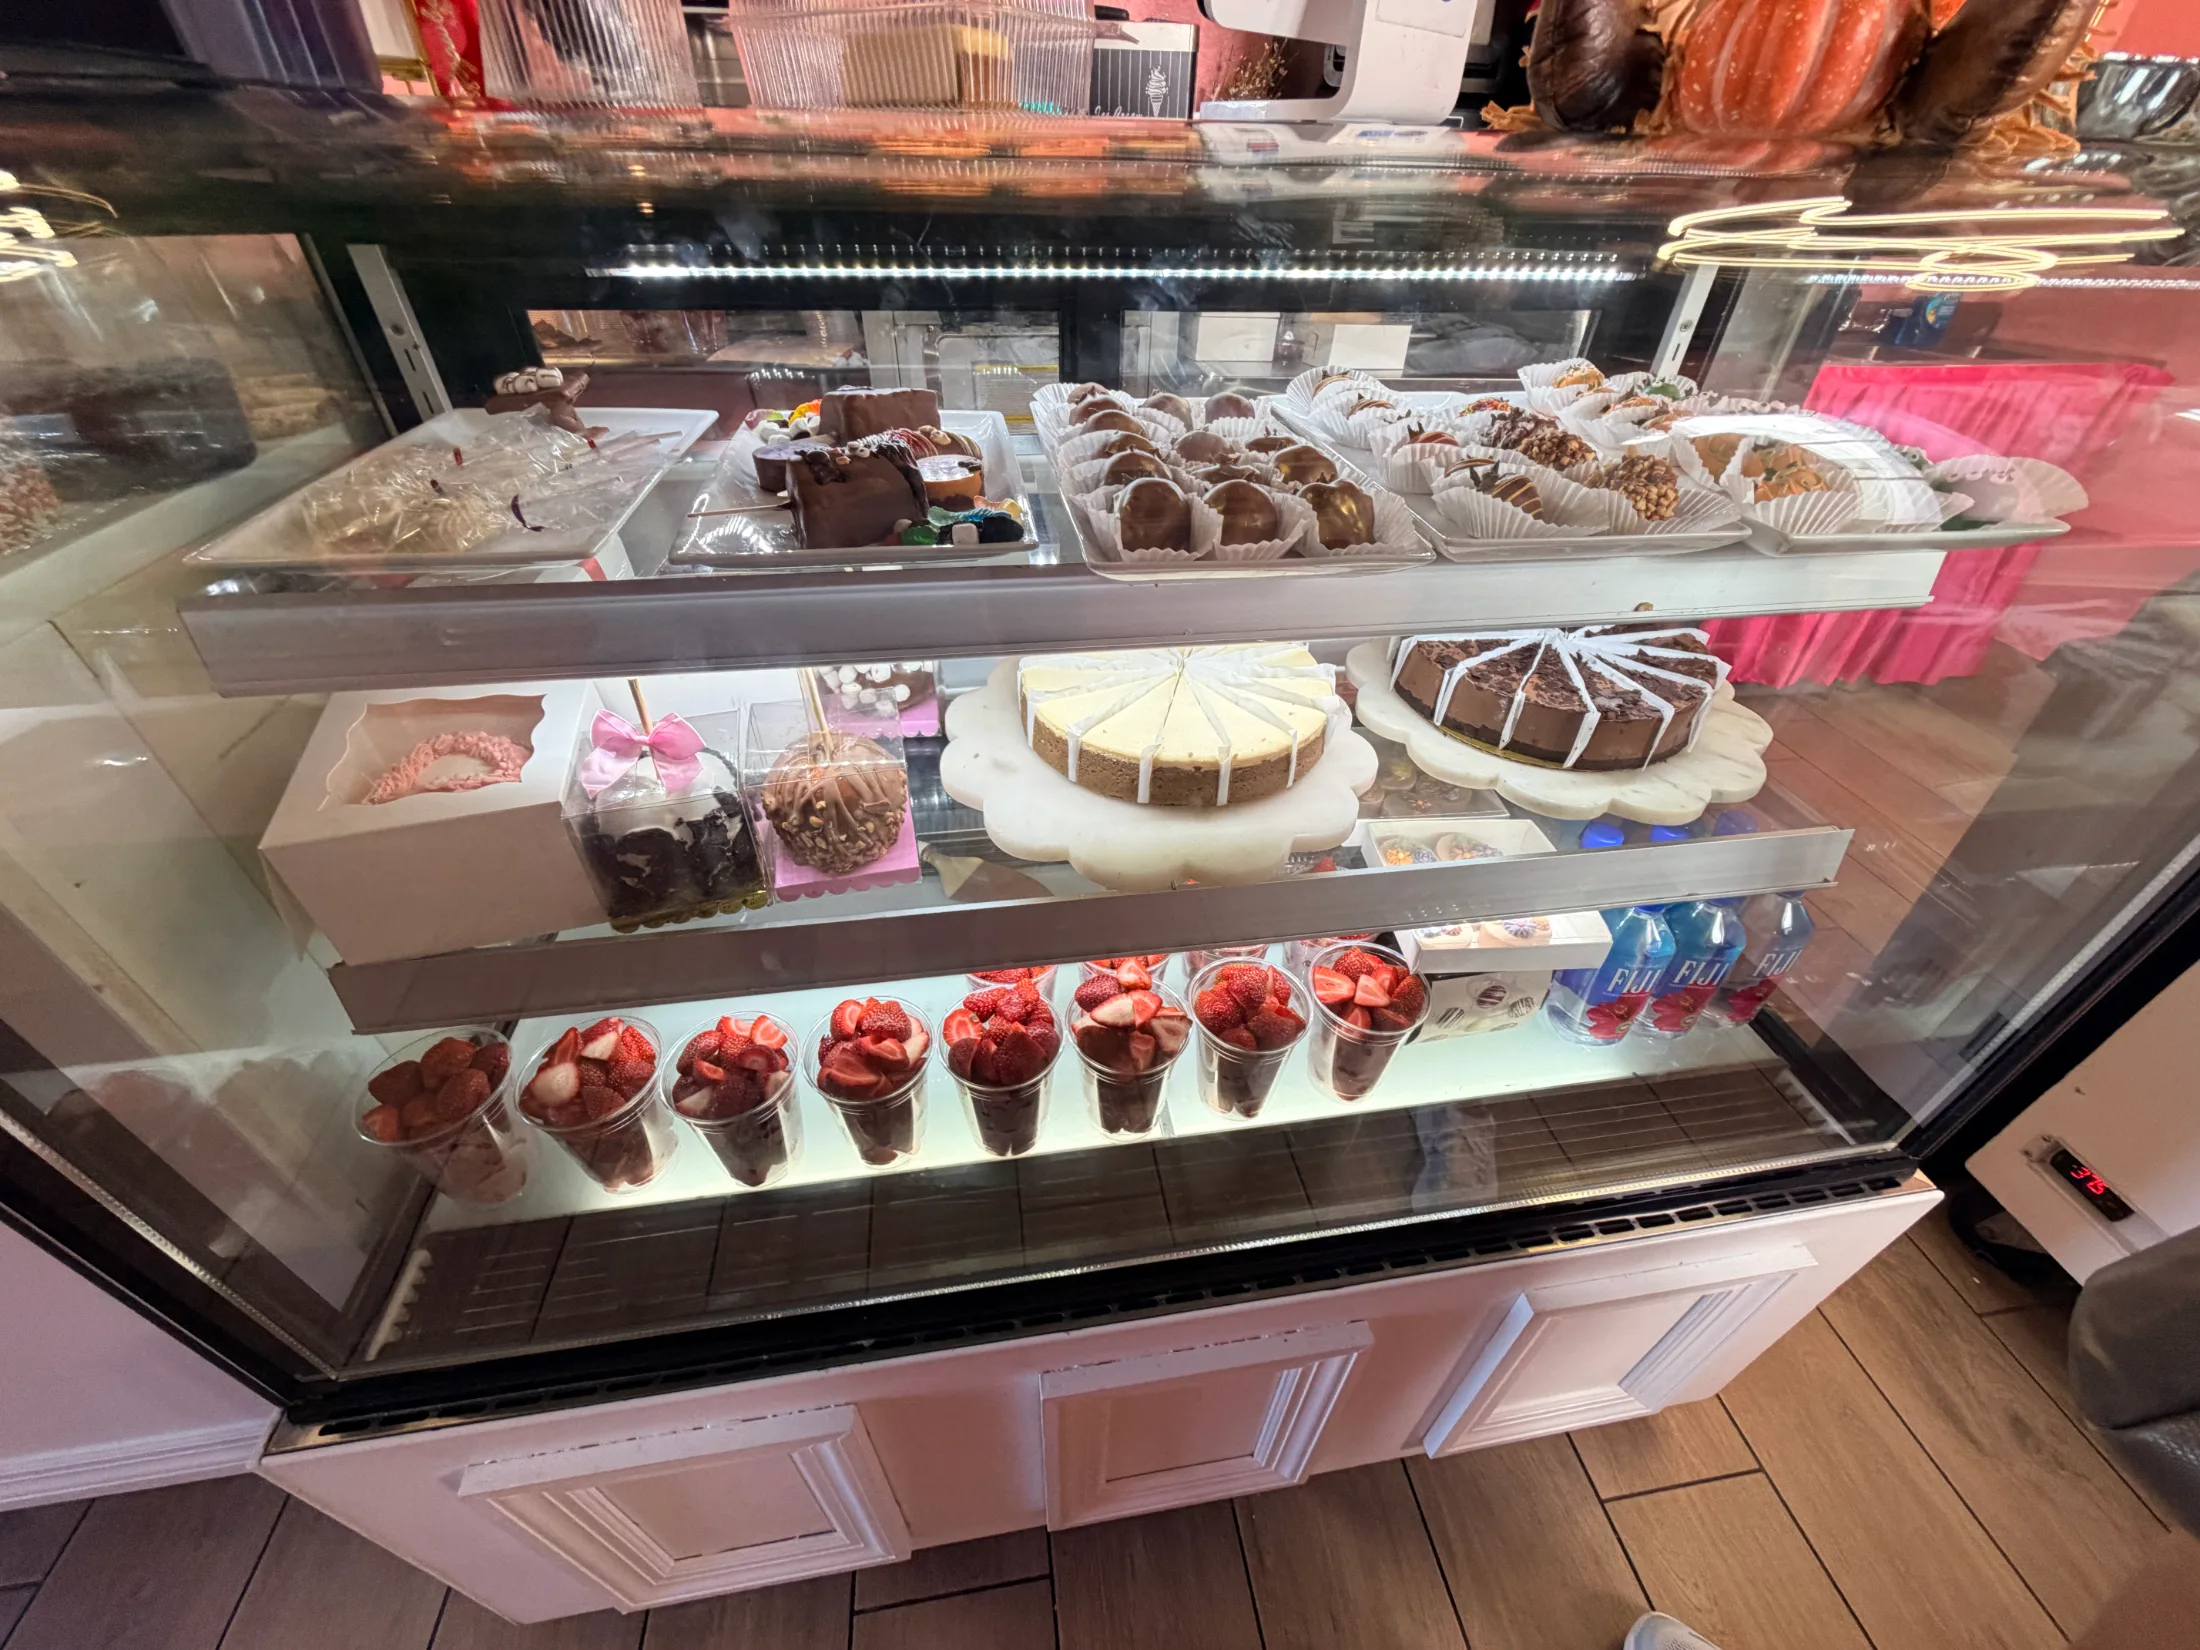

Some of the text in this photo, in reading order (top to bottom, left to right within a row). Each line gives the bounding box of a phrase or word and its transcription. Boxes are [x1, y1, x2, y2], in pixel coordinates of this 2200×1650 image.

[1672, 959, 1730, 986] FIJI
[1752, 948, 1804, 977] FIJI
[1606, 967, 1662, 994] FIJI
